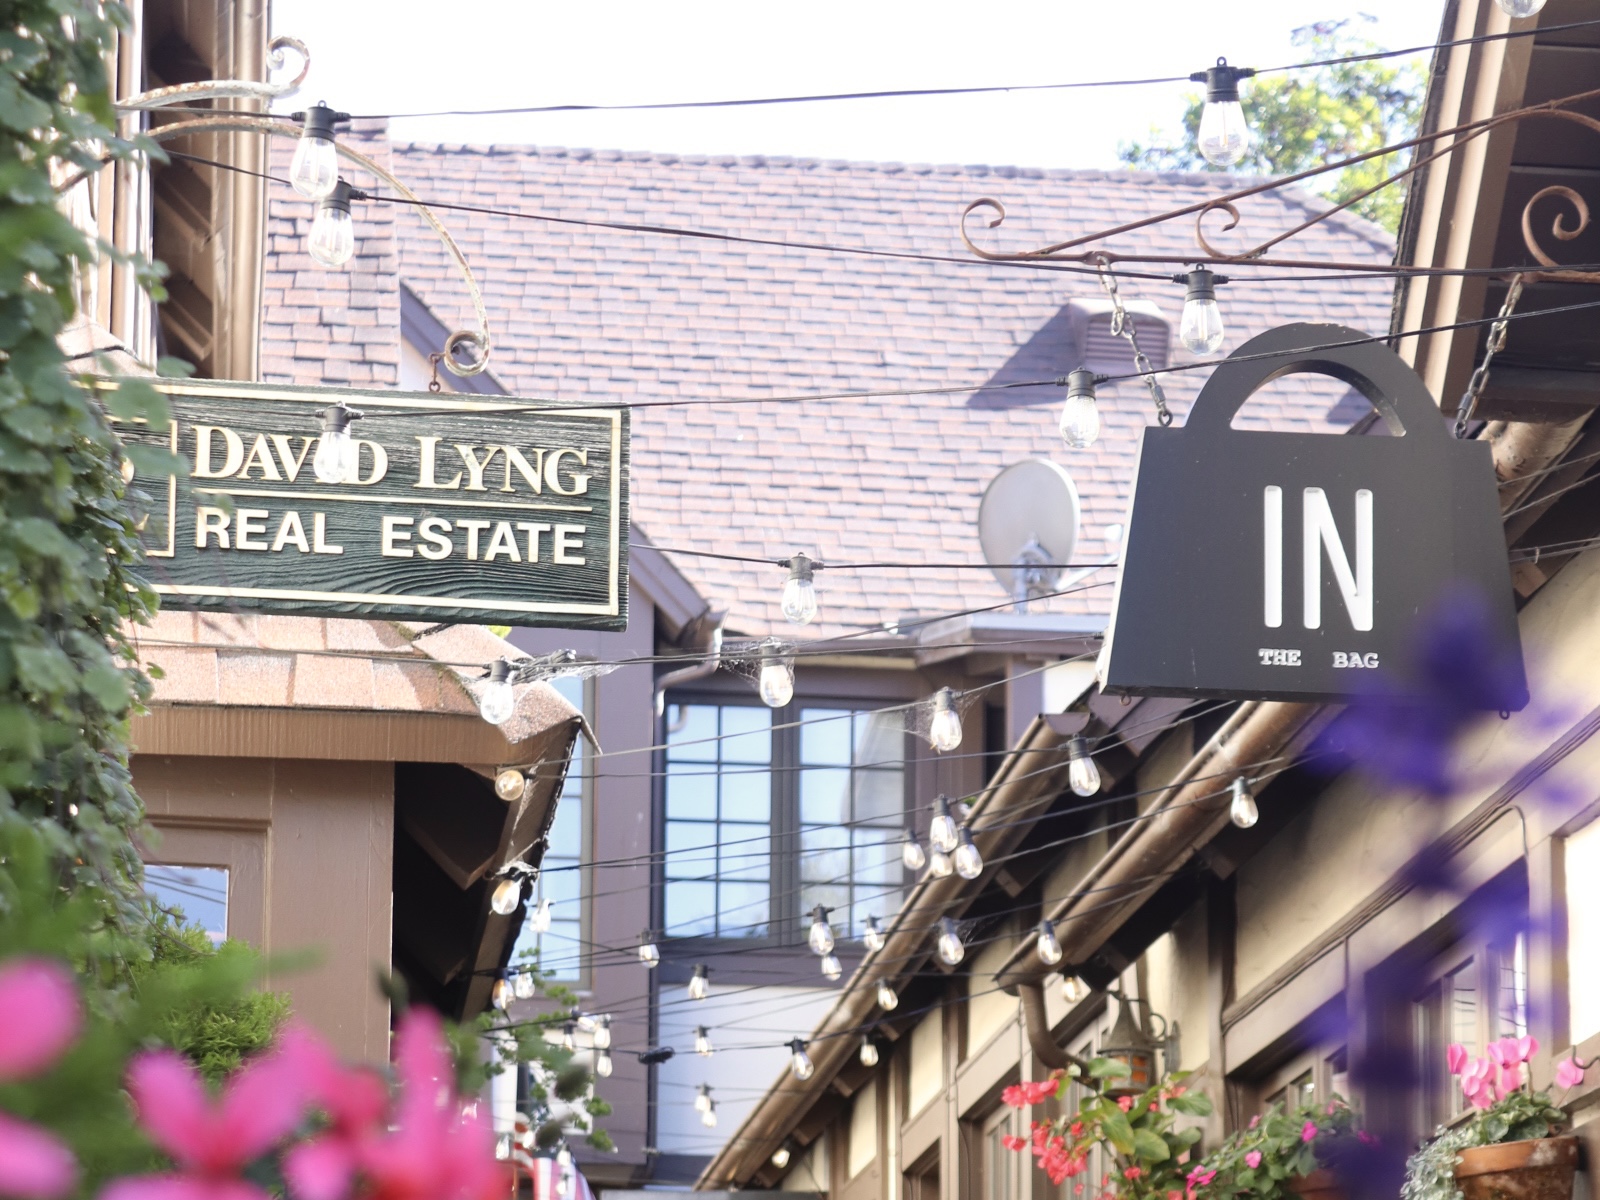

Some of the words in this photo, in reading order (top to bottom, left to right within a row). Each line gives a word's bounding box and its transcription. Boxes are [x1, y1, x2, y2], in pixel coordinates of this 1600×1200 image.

[191, 424, 389, 486] DAVD
[413, 435, 593, 496] LYNG
[196, 506, 344, 555] REAL
[381, 515, 587, 566] ESTATE
[1263, 484, 1374, 632] IN
[1258, 648, 1302, 667] THE
[1332, 650, 1380, 669] BAG
